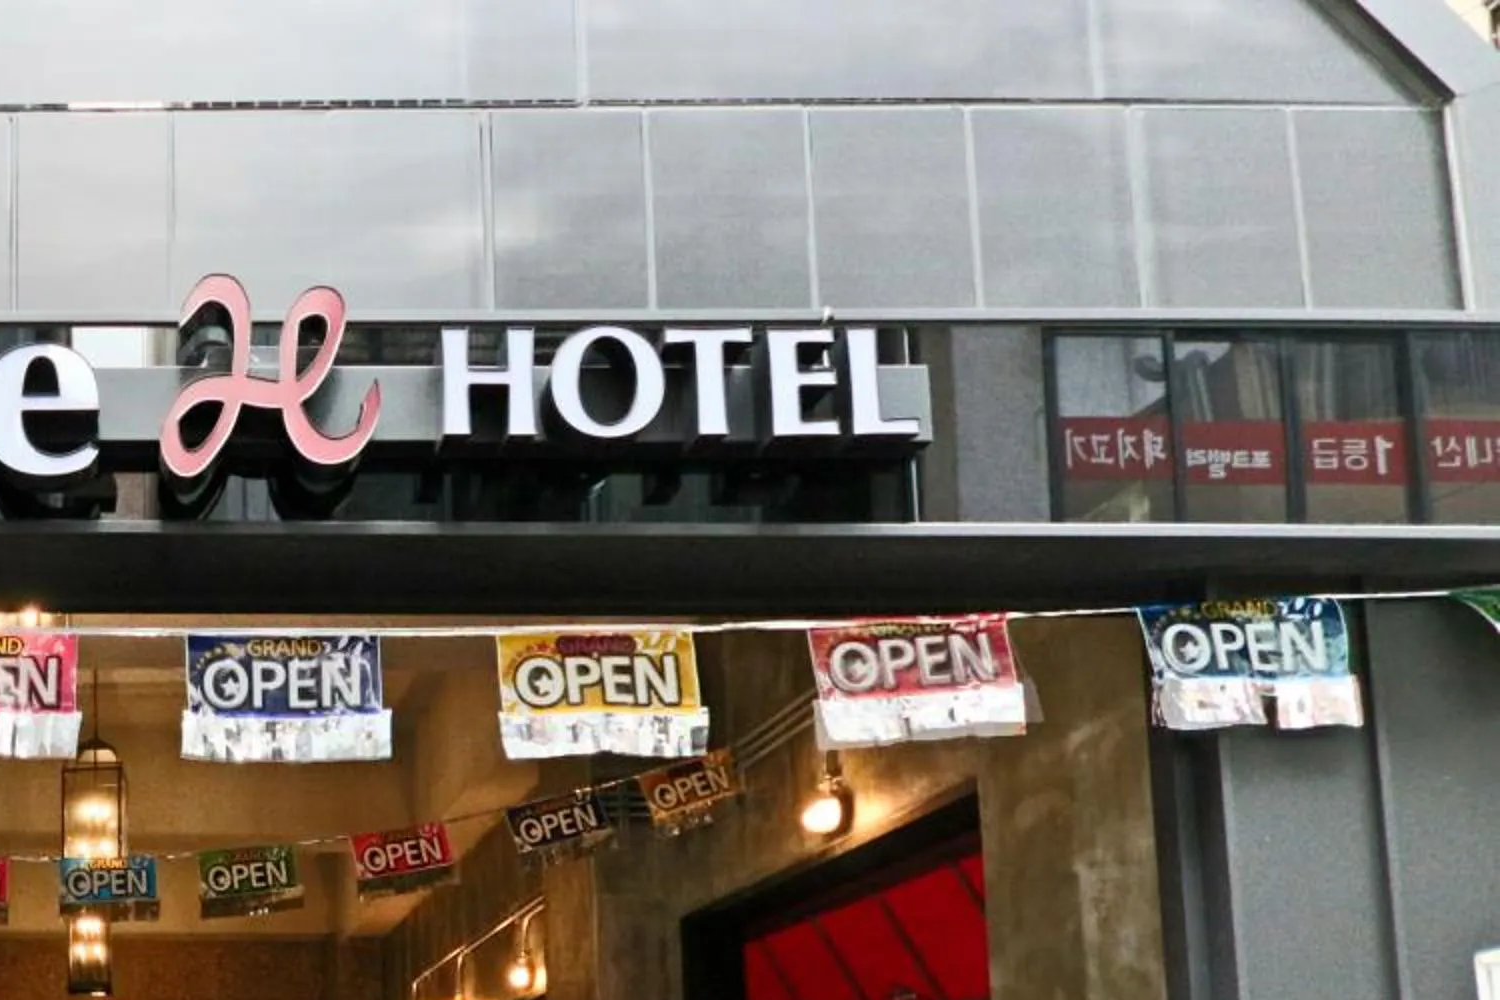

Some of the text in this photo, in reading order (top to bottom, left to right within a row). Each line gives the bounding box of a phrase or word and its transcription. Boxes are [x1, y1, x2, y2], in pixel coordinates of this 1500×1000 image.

[441, 325, 921, 439] HOTEL
[247, 639, 323, 657] GRAND
[829, 632, 997, 693] OPEN
[1161, 619, 1329, 675] OPEN
[203, 658, 362, 709] OPEN
[515, 654, 679, 706] OPEN
[653, 766, 730, 809] OPEN
[518, 803, 598, 844] OPEN
[364, 836, 443, 872] OPEN
[67, 869, 148, 898] OPEN
[208, 860, 288, 892] OPEN
